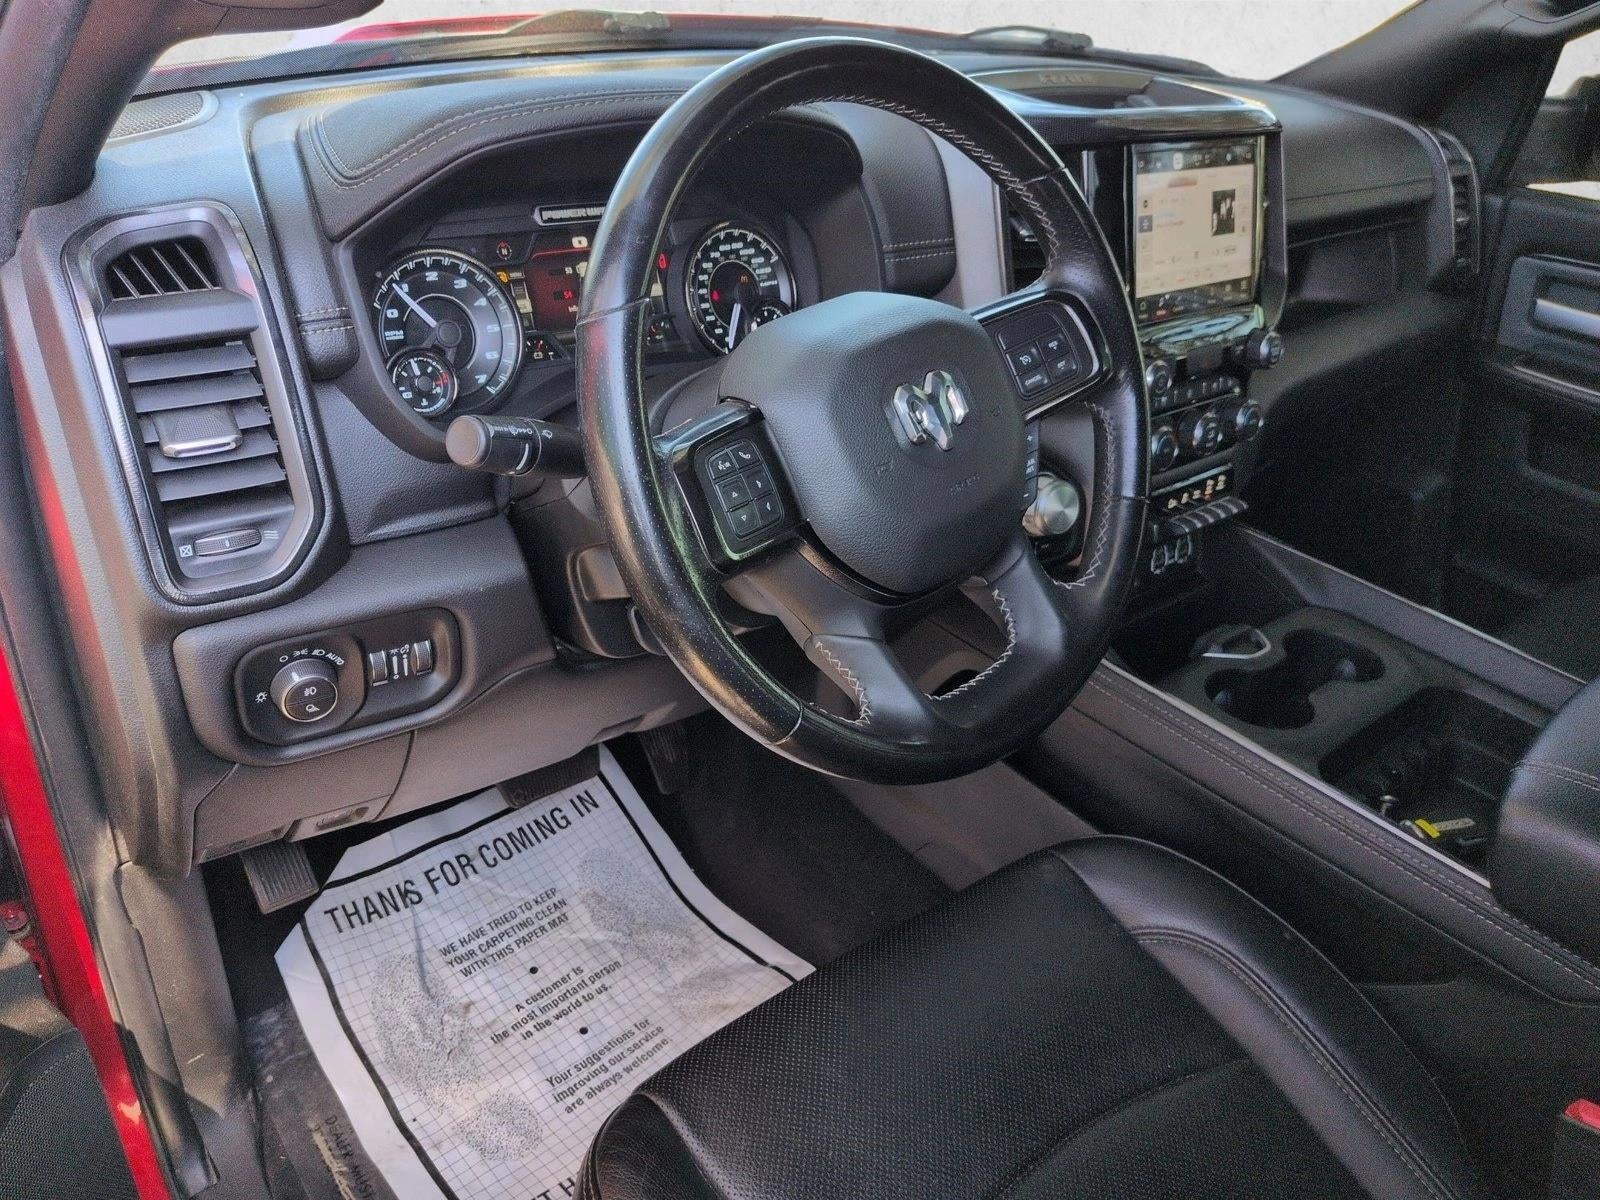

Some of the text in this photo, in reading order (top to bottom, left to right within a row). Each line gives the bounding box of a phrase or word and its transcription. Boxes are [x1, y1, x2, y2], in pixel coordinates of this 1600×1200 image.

[541, 207, 587, 220] POWER
[401, 283, 409, 292] 1
[425, 271, 439, 281] 2
[454, 278, 467, 289] 3
[386, 309, 399, 318] 0
[474, 297, 487, 306] 4
[487, 324, 500, 333] 5
[485, 351, 499, 360] 6
[475, 374, 487, 384] 7
[326, 652, 344, 665] AUTO
[424, 853, 478, 894] FOR
[478, 806, 572, 868] COMING
[569, 790, 600, 818] IN
[440, 887, 557, 957] WE HAVE TRIED TO KEEP
[447, 898, 567, 968] YOUR CARPETING CLEAN
[460, 912, 569, 977] WITH THIS PAPER MAT
[490, 960, 622, 1044] the most important person
[515, 1003, 525, 1012] A
[525, 973, 575, 1005] customer
[534, 1018, 552, 1032] the
[553, 1000, 582, 1021] world
[581, 992, 594, 1002] to
[595, 983, 612, 995] us.
[546, 1019, 651, 1088] Your suggestions for
[552, 1025, 664, 1103] improving our service
[565, 1038, 673, 1114] are always welcome.
[325, 1115, 354, 1159] DEALER
